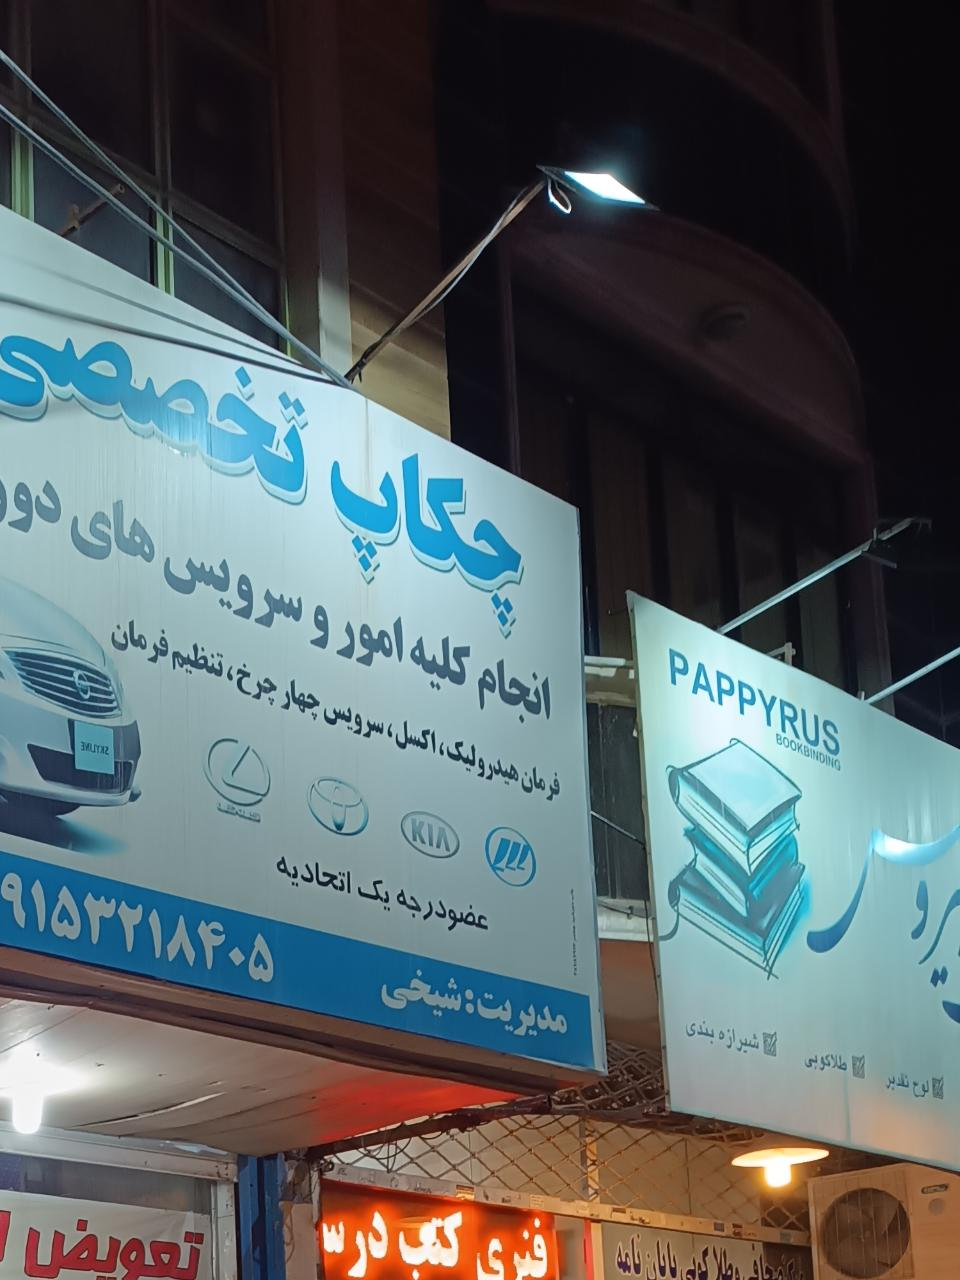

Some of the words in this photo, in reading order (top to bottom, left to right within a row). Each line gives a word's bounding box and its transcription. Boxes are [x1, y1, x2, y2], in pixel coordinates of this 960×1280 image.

[70, 499, 156, 564] های
[331, 452, 524, 636] چکاپ
[164, 548, 303, 629] سرویس
[110, 619, 169, 663] فرمان
[171, 642, 224, 678] تنظیم
[336, 616, 404, 667] امور
[410, 636, 471, 691] کلیه
[281, 680, 321, 721] چهار
[477, 658, 551, 724] انجام
[668, 647, 842, 757] PAPPYRUS
[323, 705, 384, 738] سرویس
[775, 733, 842, 772] BOOKBINDING
[521, 766, 561, 801] فرمان
[411, 818, 451, 852] KIA
[276, 856, 351, 894] اتحادیه
[357, 879, 390, 911] یک
[719, 1028, 760, 1053] شیرازه
